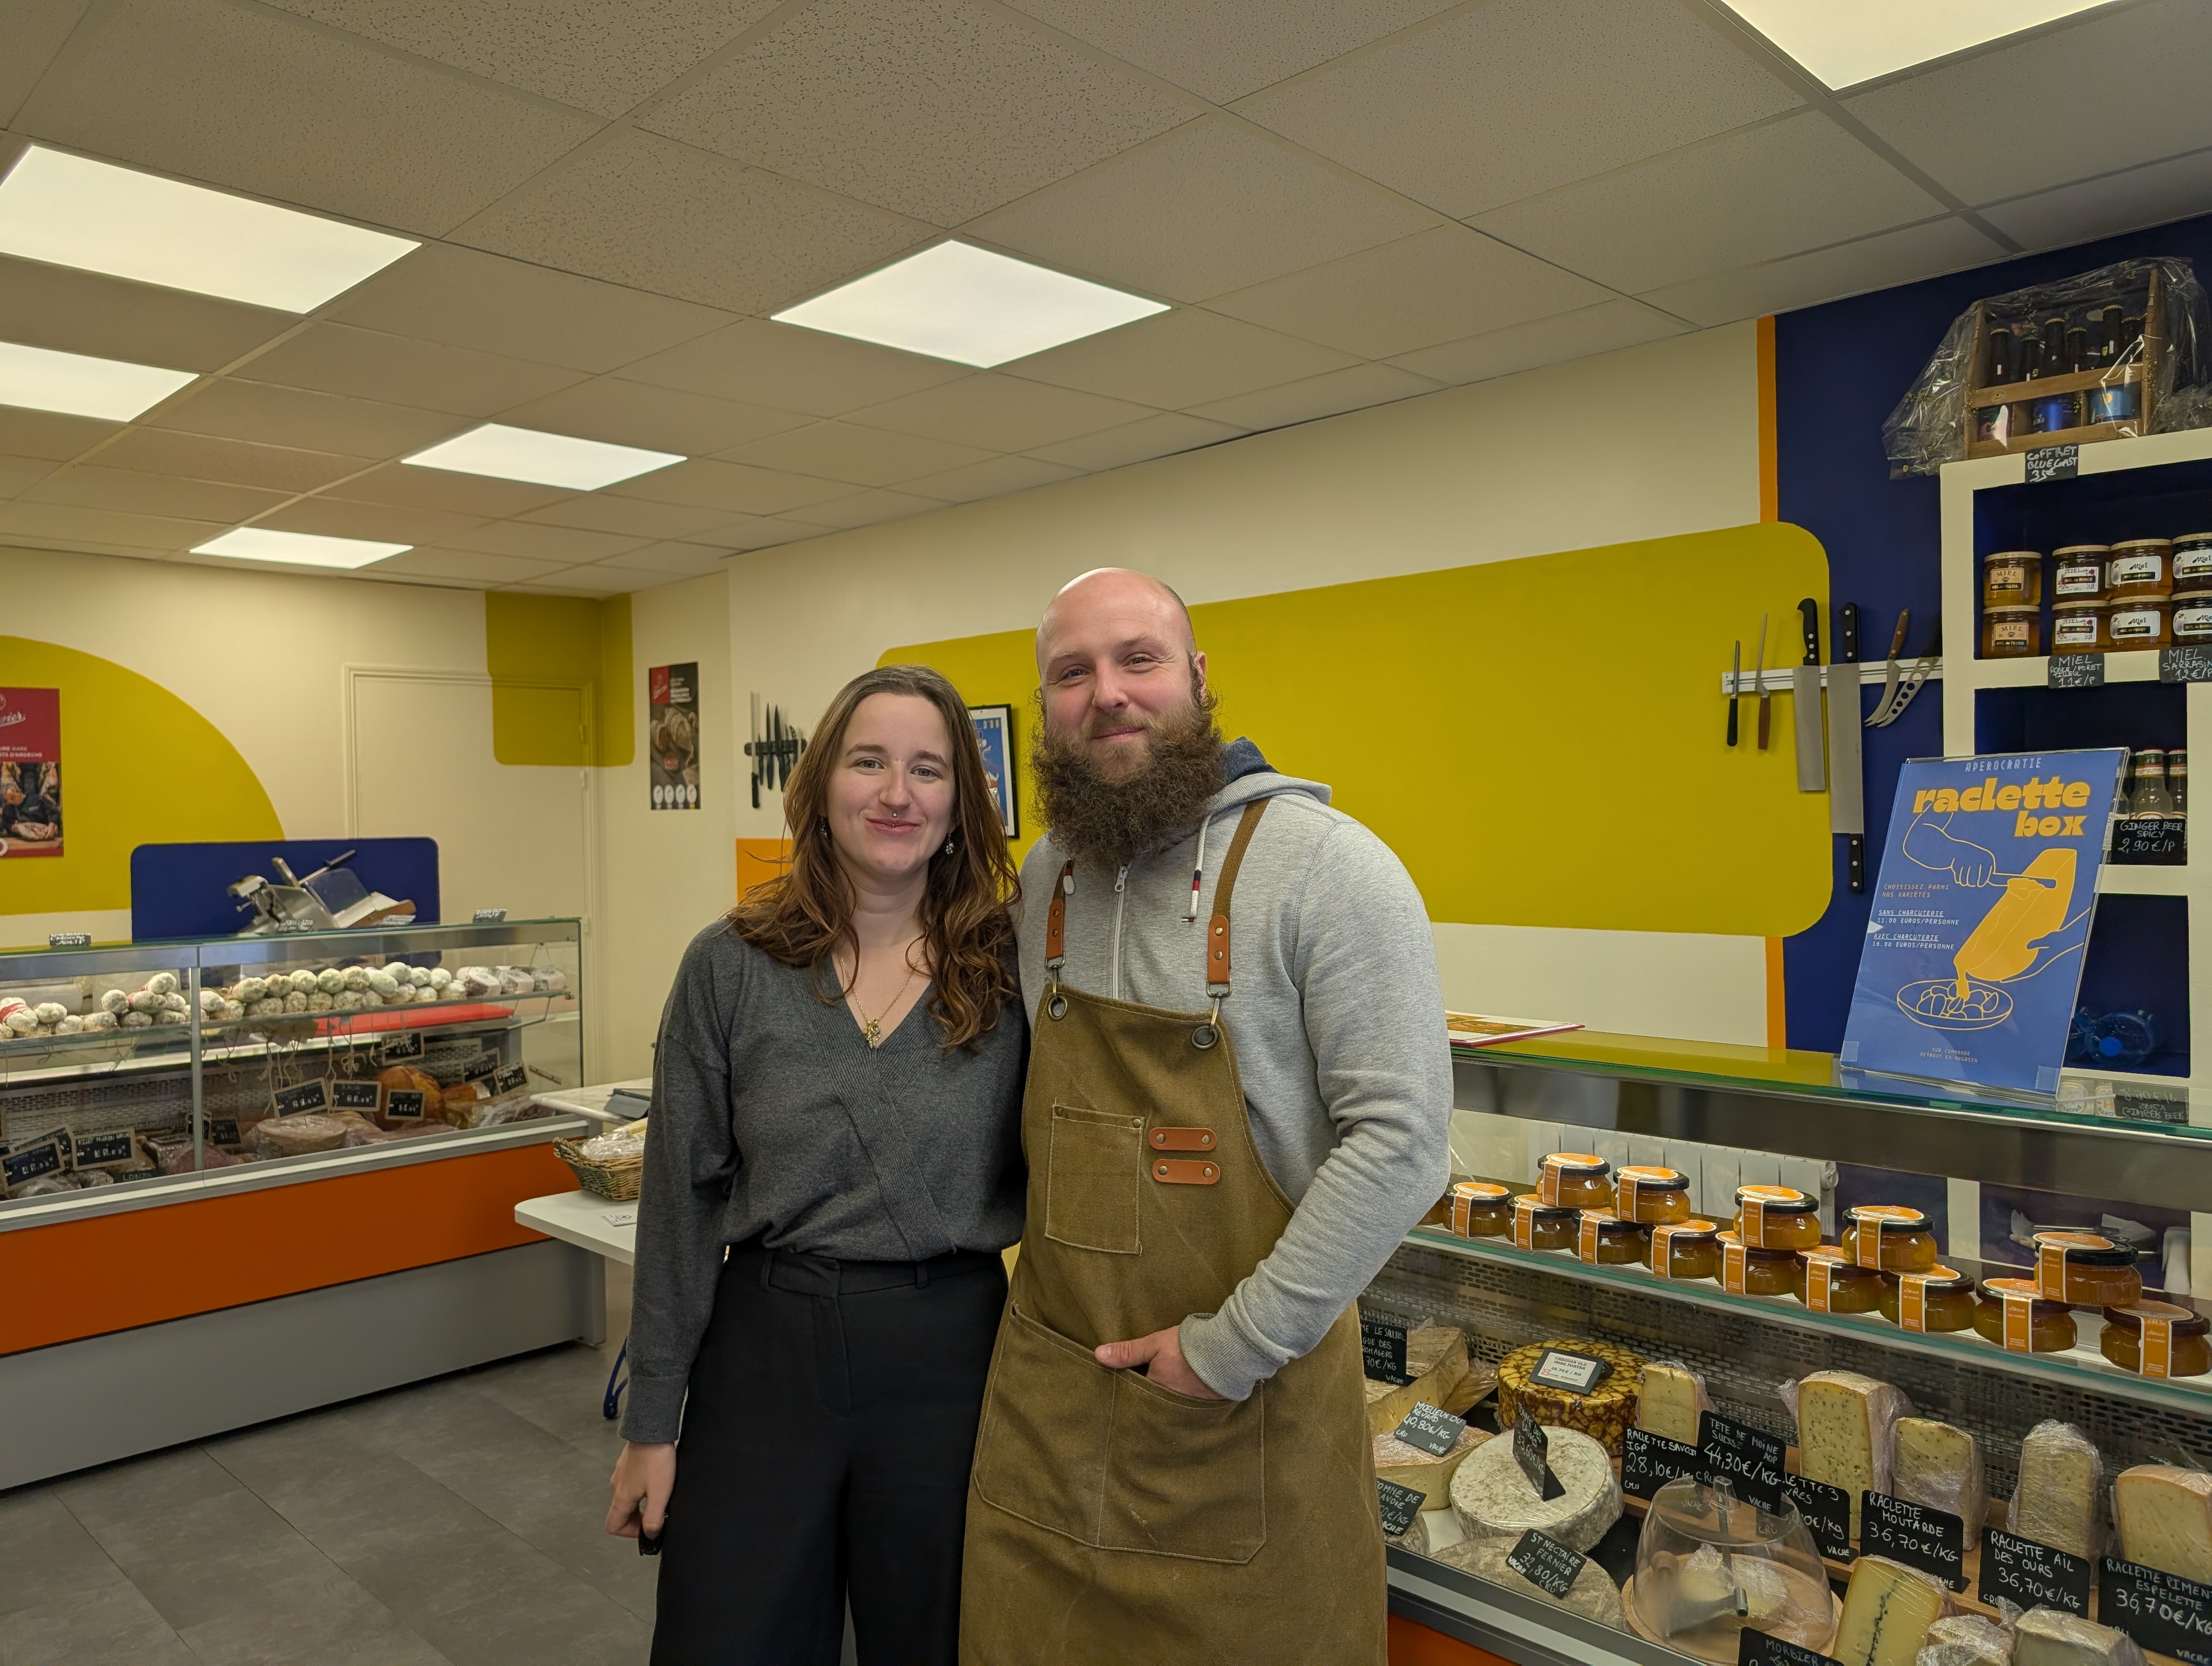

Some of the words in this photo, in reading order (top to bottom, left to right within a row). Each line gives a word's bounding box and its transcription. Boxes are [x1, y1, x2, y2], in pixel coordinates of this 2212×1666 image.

[2027, 445, 2077, 460] COFFRET
[2029, 466, 2056, 482] 35€
[1965, 757, 2042, 772] APEROCRATIE
[1913, 776, 2090, 813] raclette
[2014, 810, 2087, 837] box
[2120, 820, 2160, 831] GINGER
[2162, 821, 2183, 832] BEER
[2137, 830, 2165, 838] SPICY
[1898, 890, 1931, 898] VARIÉTÉS
[1893, 933, 1939, 941] CHARCUTERIE
[1895, 941, 1954, 950] EUROS/PERSONNE
[1379, 1339, 1392, 1349] DES
[1554, 1356, 1577, 1364] CHEDDAR
[1385, 1374, 1404, 1384] VACHE
[1412, 1408, 1438, 1422] REVARD
[1449, 1415, 1463, 1424] DU
[1403, 1413, 1450, 1439] 40,80€/KG
[1709, 1417, 1731, 1434] TETE
[1736, 1430, 1747, 1441] DE
[1396, 1429, 1409, 1437] CRU
[1429, 1442, 1446, 1453] VACHE
[1626, 1440, 1647, 1453] IGP
[1763, 1452, 1778, 1464] AOP
[1405, 1493, 1420, 1503] DE
[1828, 1488, 1839, 1501] 3
[1748, 1495, 1772, 1512] VACHE
[1870, 1491, 1922, 1520] RACLETTE
[1382, 1521, 1404, 1534] ACHE
[1882, 1510, 1944, 1537] MOUTARDE
[1531, 1533, 1544, 1544] ST
[1542, 1540, 1581, 1568] NECTAIRE
[1827, 1545, 1850, 1556] VACHE
[1991, 1530, 2043, 1560] RACLETTE
[2054, 1553, 2074, 1572] AIL
[1995, 1548, 2014, 1564] DES
[2022, 1559, 2053, 1578] OURS
[2106, 1558, 2161, 1584] RACLETTE
[1539, 1580, 1556, 1593] CRU
[1998, 1567, 2081, 1609] 36,70€/KG
[2136, 1579, 2203, 1611] ESPELETTE
